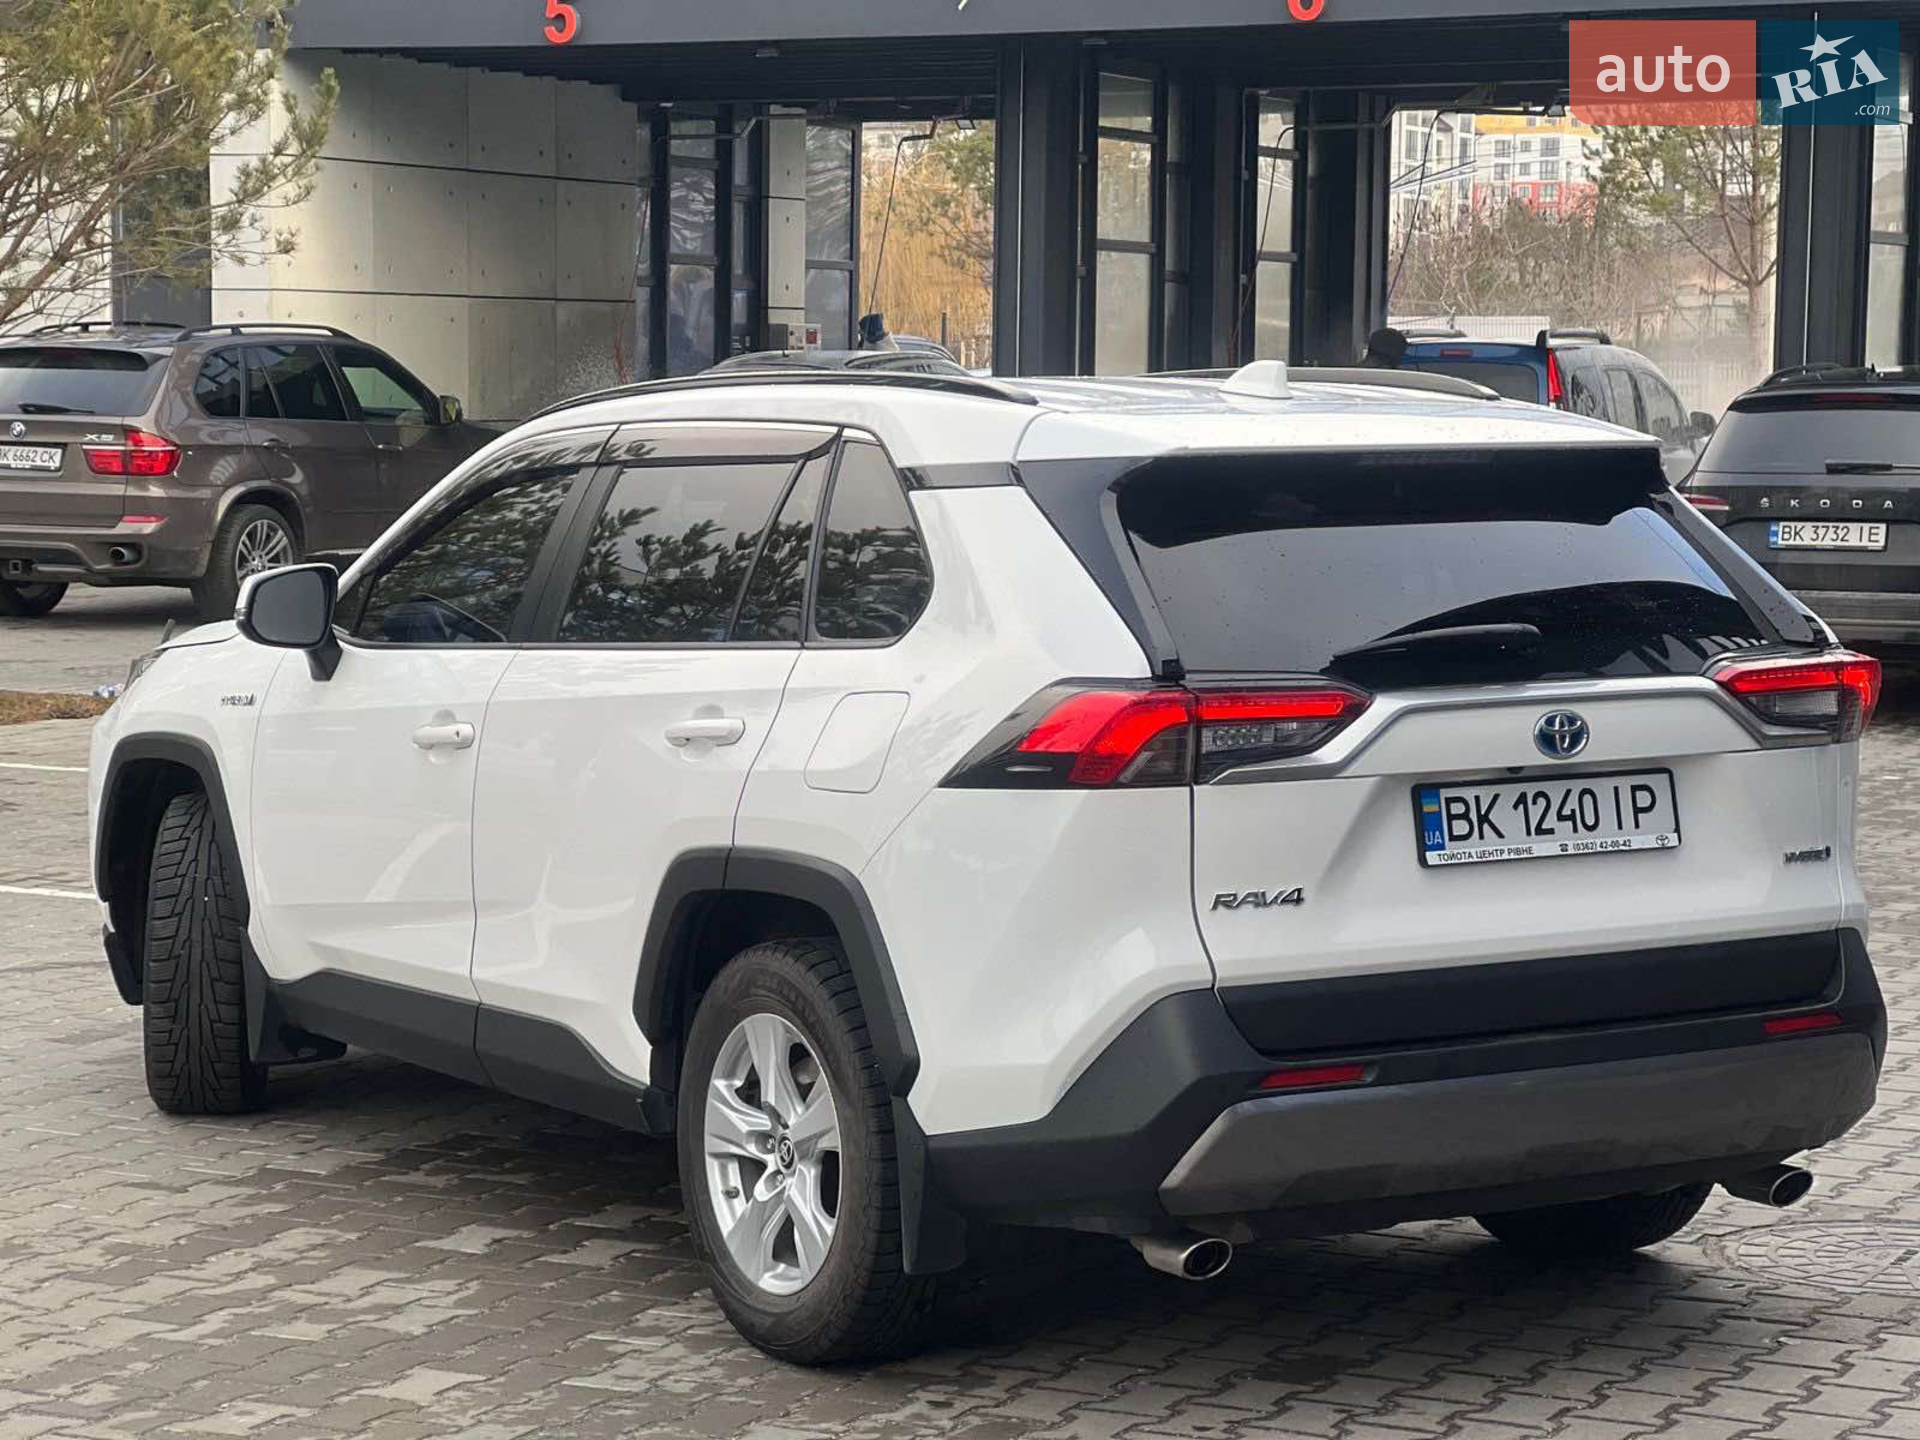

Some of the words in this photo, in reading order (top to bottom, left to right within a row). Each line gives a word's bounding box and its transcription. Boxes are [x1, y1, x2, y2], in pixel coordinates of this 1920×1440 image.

[544, 0, 577, 43] 5
[0, 447, 11, 462] K
[12, 448, 38, 463] 6662
[40, 450, 58, 465] CK
[1782, 525, 1805, 542] BK
[1811, 525, 1850, 542] 3732
[1860, 526, 1880, 543] IE
[1444, 793, 1505, 842] BK
[1512, 788, 1601, 837] 1240
[1613, 784, 1657, 830] IP
[1424, 830, 1443, 846] UA
[1437, 851, 1475, 863] ТОЙОТА
[1475, 848, 1506, 860] ЦЕНТР
[1508, 846, 1535, 857] РІВНЕ
[1209, 886, 1305, 912] RAV4
